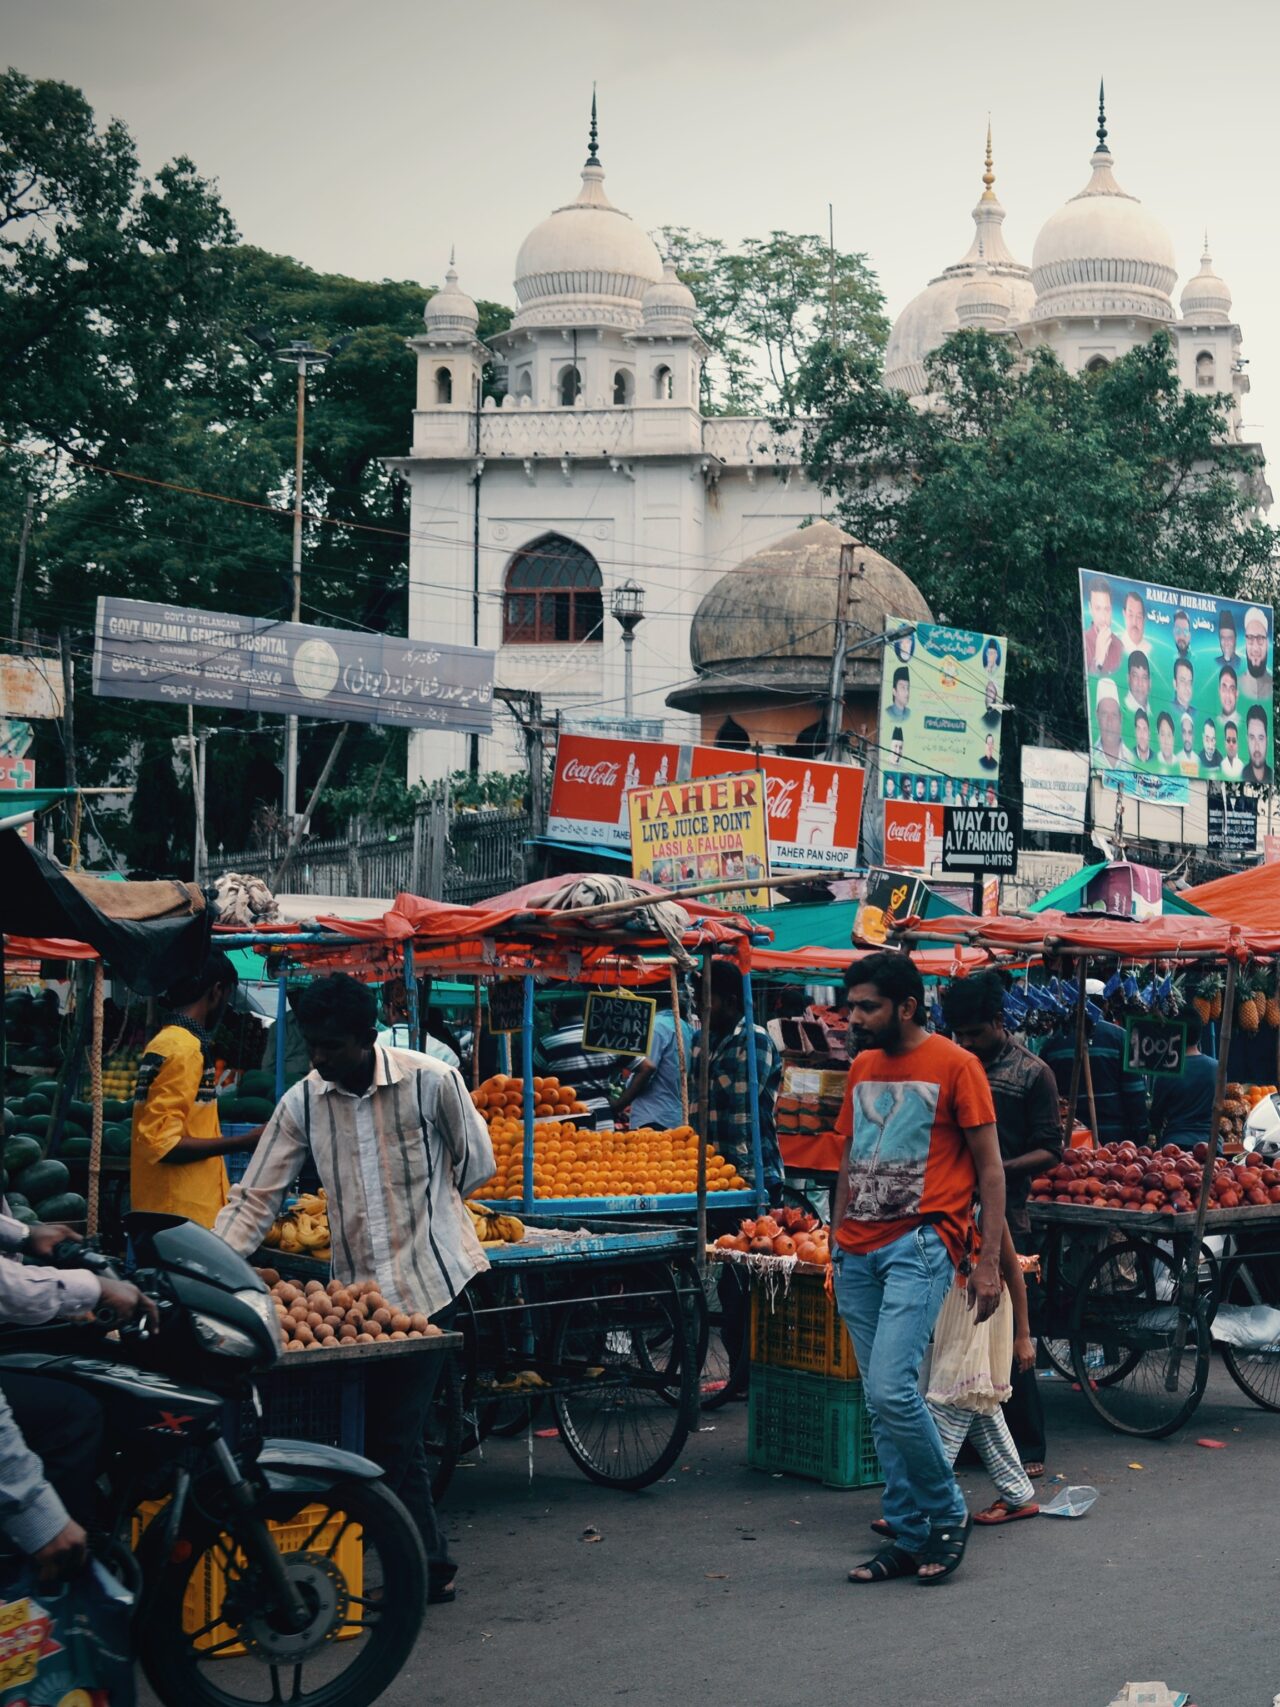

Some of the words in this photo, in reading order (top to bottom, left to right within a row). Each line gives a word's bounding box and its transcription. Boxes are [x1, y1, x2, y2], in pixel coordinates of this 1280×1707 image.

[1146, 588, 1178, 605] RAMZAN
[1180, 595, 1217, 613] MUBARAK
[187, 615, 196, 624] OF
[199, 616, 241, 630] TELANGANA
[109, 617, 140, 636] GOVT
[143, 621, 188, 642] NIZAMIA
[190, 627, 237, 649] GENERAL
[240, 634, 288, 655] HOSPITAL
[562, 759, 621, 786] Coca-Cola
[634, 778, 759, 822] TAHER
[642, 821, 669, 843] LIVE
[672, 816, 709, 840] JUICE
[713, 810, 751, 833] POINT
[887, 821, 922, 843] Coca-Cola
[953, 811, 986, 832] WAY
[988, 811, 1009, 832] TO
[612, 830, 631, 840] TAHE
[652, 842, 682, 859] LASSI
[687, 839, 694, 851] &
[697, 833, 743, 854] FALUDA
[945, 832, 966, 851] A.V.
[967, 831, 1014, 851] PARKING
[777, 846, 805, 859] TAHER
[807, 849, 824, 861] PAN
[825, 851, 849, 862] SHOP
